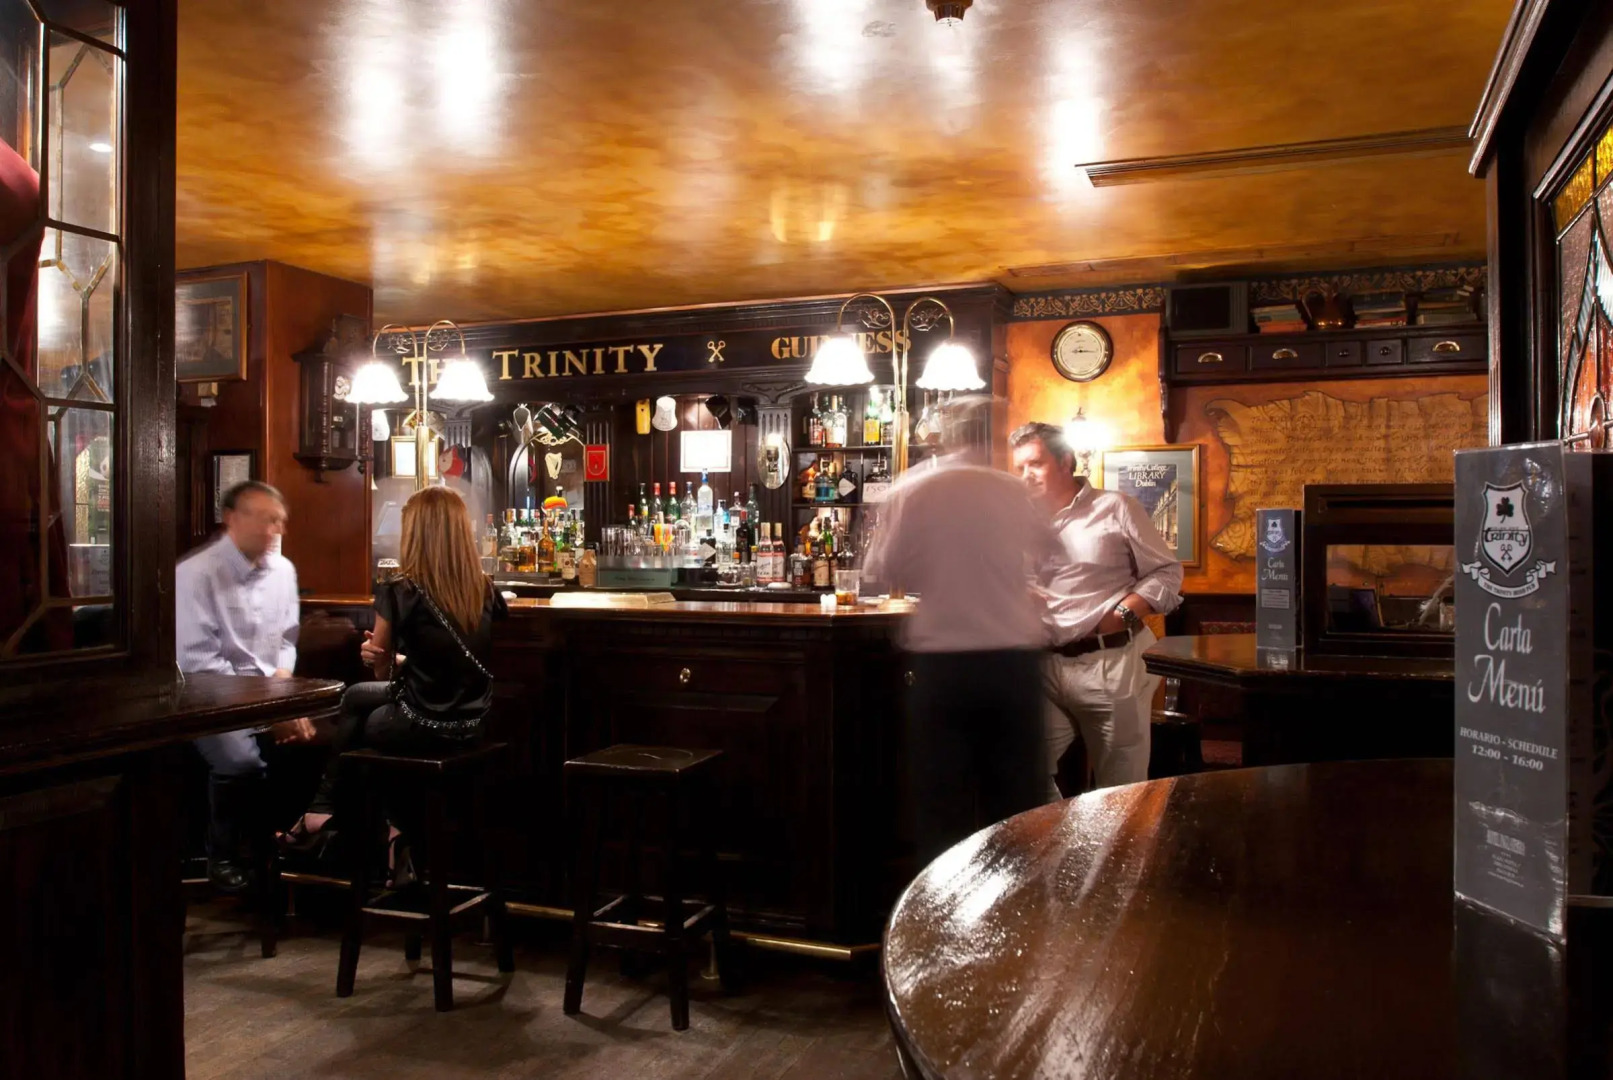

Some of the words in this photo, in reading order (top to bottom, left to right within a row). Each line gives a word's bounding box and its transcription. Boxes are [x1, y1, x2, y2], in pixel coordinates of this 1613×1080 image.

[771, 329, 912, 360] GUIESS
[492, 344, 664, 380] TRINITY
[1129, 471, 1165, 480] LIBRARY
[1135, 479, 1157, 488] Dublin
[1484, 602, 1533, 654] Carta
[1467, 654, 1546, 714] Menú
[1460, 727, 1500, 745] HORARIO
[1507, 738, 1559, 760] SCHEDULE
[1472, 744, 1501, 761] 12:00
[1512, 754, 1544, 771] 16:00
